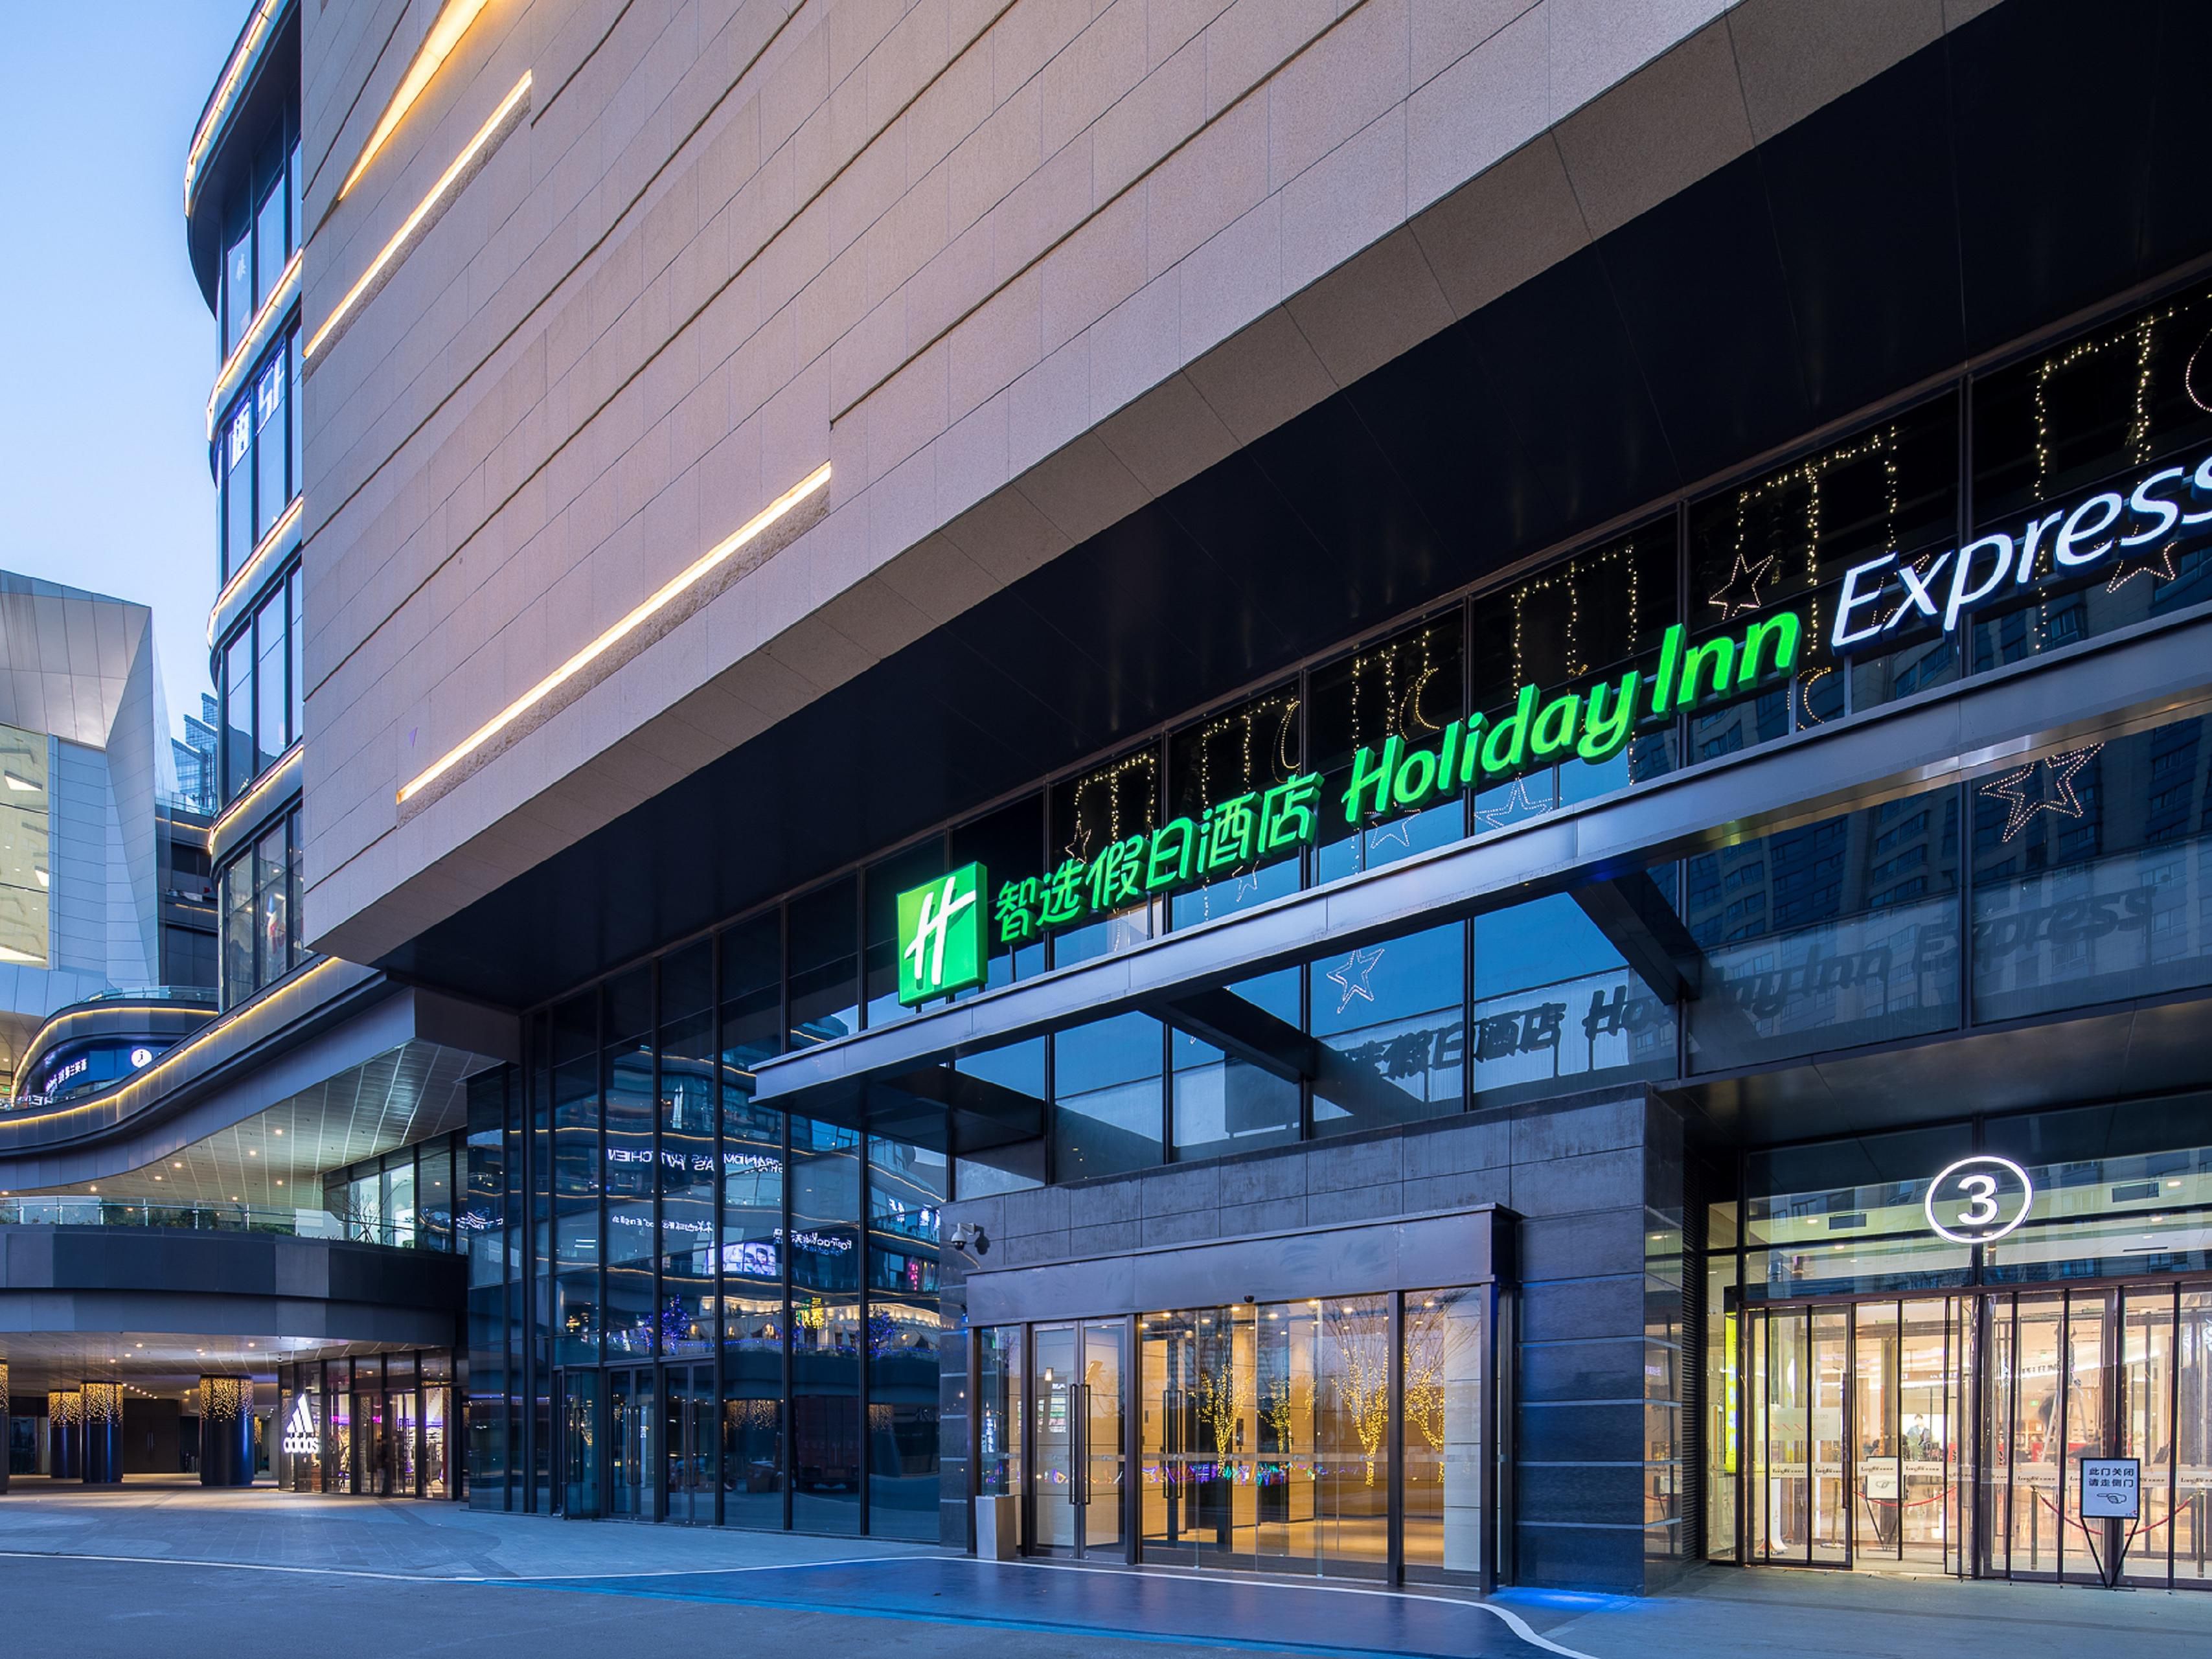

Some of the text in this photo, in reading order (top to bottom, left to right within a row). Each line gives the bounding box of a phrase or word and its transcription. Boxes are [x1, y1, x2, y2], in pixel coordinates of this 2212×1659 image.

[1341, 670, 1642, 826] Holiday
[1652, 611, 1801, 720] Inn
[996, 772, 1325, 944] 智选假日酒店
[1957, 1174, 1998, 1225] 3
[283, 1432, 319, 1454] adidas
[2088, 1467, 2134, 1476] 此门关闭
[2088, 1478, 2134, 1488] 请走侧门
